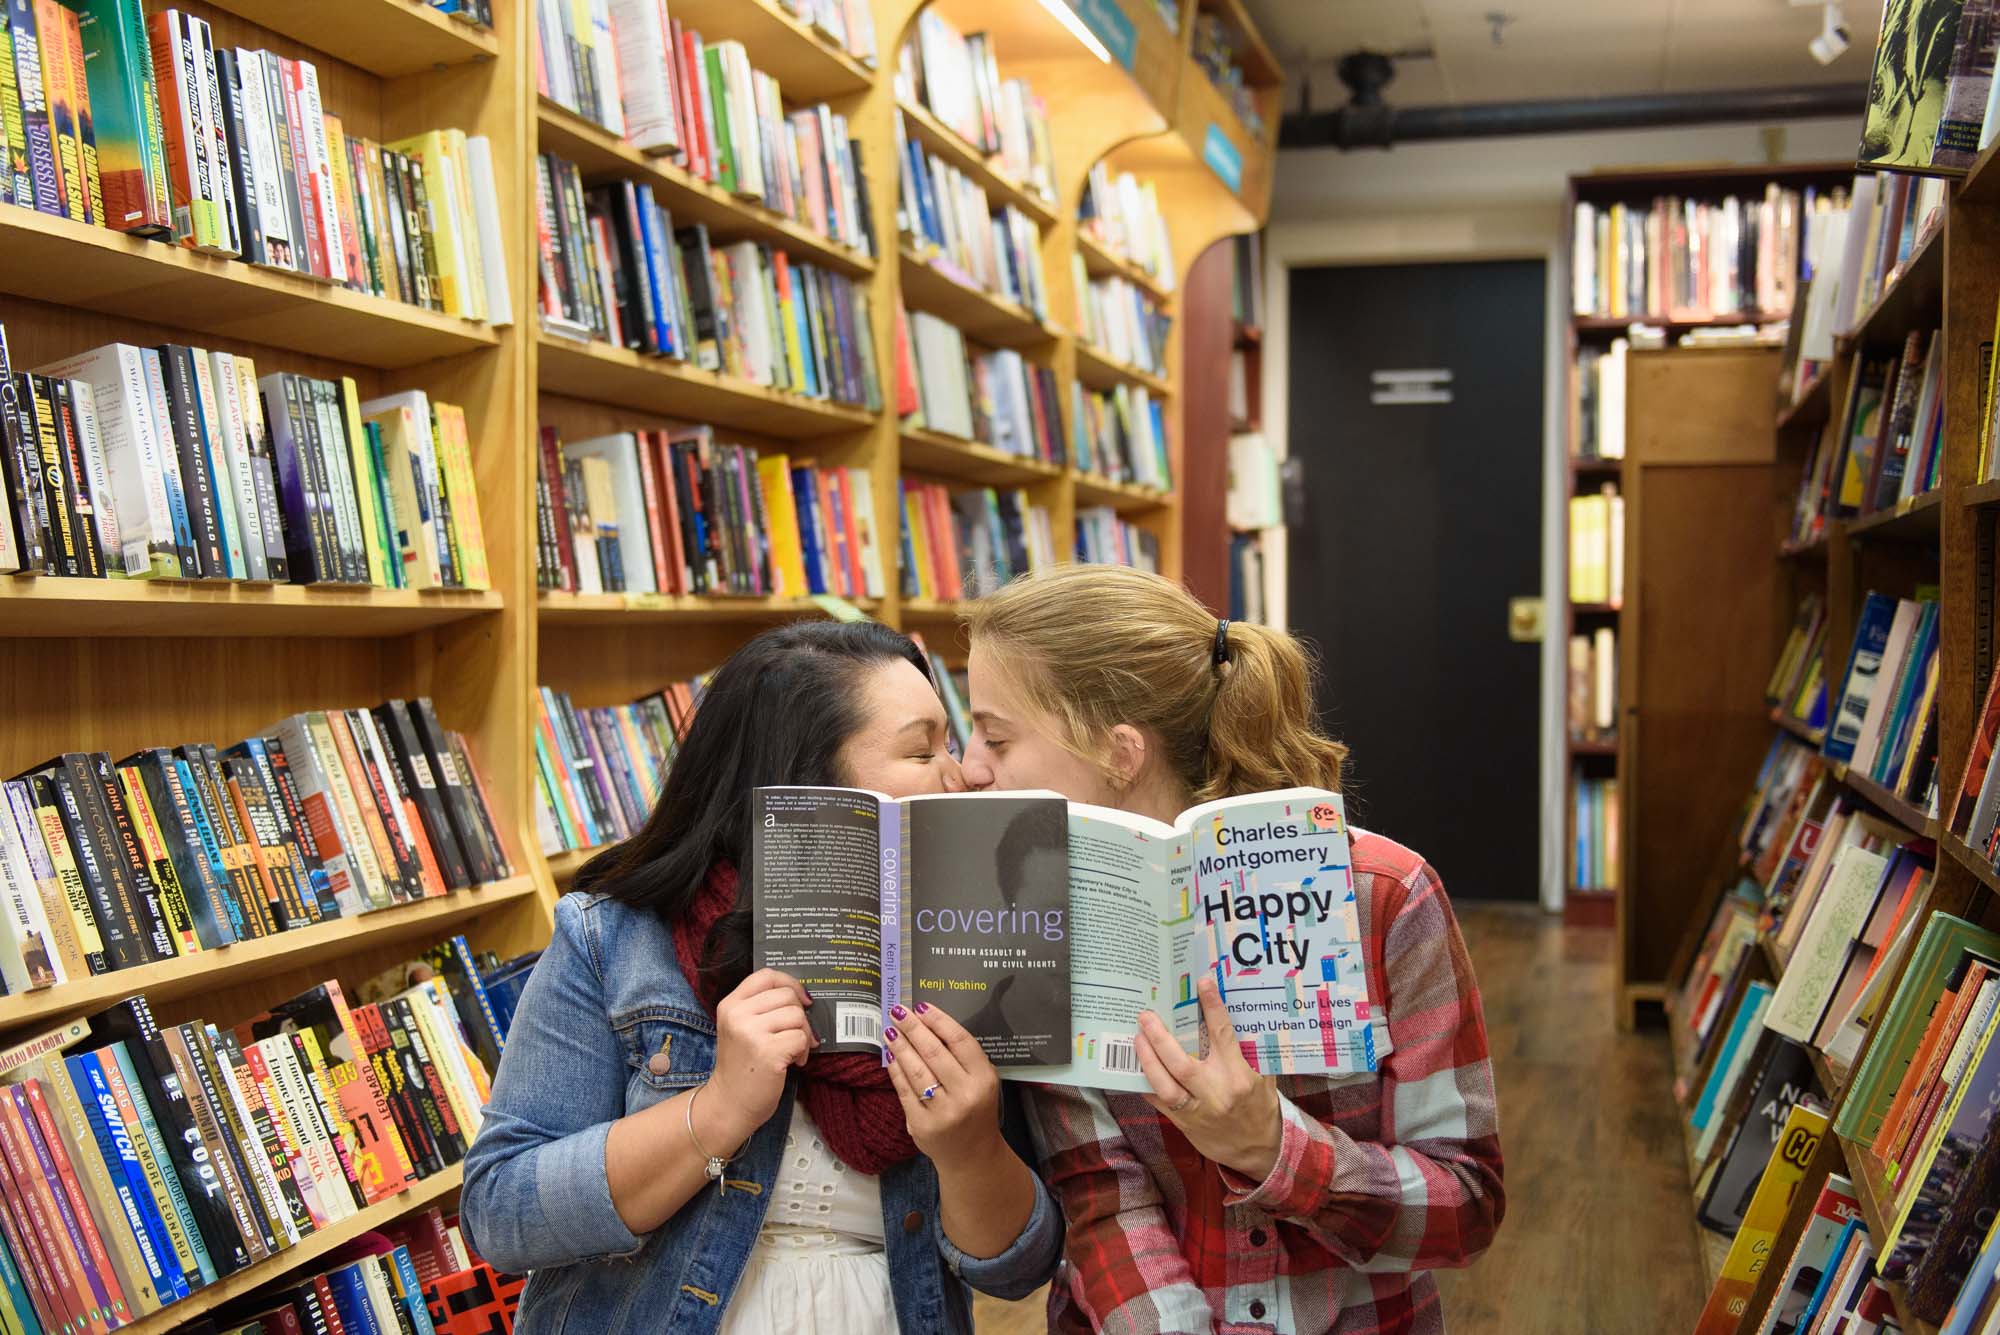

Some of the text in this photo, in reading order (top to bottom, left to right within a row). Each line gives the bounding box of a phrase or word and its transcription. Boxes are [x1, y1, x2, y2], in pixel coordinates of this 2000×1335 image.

[13, 26, 37, 112] KELLERMAN
[26, 34, 46, 112] JONATHAN
[182, 38, 212, 201] the kepler
[312, 114, 326, 160] TEMPLAR
[144, 93, 165, 201] MURDERER'S DAUGHTER
[15, 174, 33, 209] GUILT
[31, 128, 59, 214] OBSESSION
[59, 133, 85, 224] COMPULSION
[83, 143, 106, 227] COMPULSION
[218, 161, 231, 200] kepler
[1, 383, 17, 422] Cut
[130, 367, 153, 461] WILLIAM LANDAY
[34, 392, 61, 466] JON LAND
[177, 355, 216, 542] RICHARD THIS WICKED WORLD
[221, 360, 260, 538] JOHN LAWTON BLACK OUT
[61, 405, 94, 549] MISSION WILLIAM
[106, 508, 121, 551] DEFENDING
[262, 509, 275, 544] DEATH
[267, 493, 281, 533] LITTLE
[416, 757, 432, 786] ALEX
[444, 755, 459, 784] ALEX
[165, 766, 194, 825] PATRICK LEE
[193, 763, 227, 848] DENNIS LEHANE
[209, 760, 244, 844] DENNIS LEHANE
[256, 754, 292, 834] DENNIS LEHANE
[50, 814, 66, 841] JOHN
[104, 783, 145, 870] JOHN LE CARRÉ
[186, 788, 220, 865] DENNIS LEHANE
[300, 815, 319, 857] LEHANE
[387, 816, 410, 863] ISLAND
[1216, 821, 1299, 847] Charles
[59, 782, 115, 921] MOST WANTED MAN
[1170, 865, 1192, 876] Happy
[1199, 844, 1329, 877] Montgomery
[13, 893, 31, 926] TRAITOR
[60, 868, 82, 912] PILGRIM
[69, 868, 97, 928] THE SECRET
[115, 881, 139, 935] MISSION SONG
[167, 892, 183, 928] Panama
[169, 880, 185, 914] Tailor
[881, 848, 901, 927] covering
[1122, 885, 1132, 894] City
[1203, 889, 1333, 926] Happy
[146, 893, 173, 956] MOST WANTED
[916, 902, 1064, 942] covering
[884, 943, 897, 971] Kenji
[931, 947, 1027, 957] THE HIDDEN ASSAULT ON
[983, 960, 1057, 968] OUR CIVIL RIGHTS
[1232, 931, 1311, 971] City
[919, 978, 987, 991] Kenji Yoshino
[1226, 997, 1351, 1014] nsforming Our Lives
[131, 1000, 152, 1042] LEONARD
[139, 996, 158, 1033] ELMORE
[1232, 1018, 1352, 1034] rough Urban Design
[27, 1032, 67, 1059] BREMONT
[51, 1060, 73, 1105] DONNA
[164, 1077, 184, 1102] BE
[183, 1028, 227, 1125] ELMORE LEONARD
[232, 1065, 257, 1113] LEONARD
[242, 1063, 266, 1109] ELMORE
[264, 1076, 283, 1116] ELMORE
[362, 1066, 391, 1121] LEONARD
[41, 1111, 57, 1139] DONNA
[90, 1068, 138, 1162] THE SWITCH
[268, 1057, 325, 1184] Elmore Leonard STICK
[286, 1055, 340, 1178] Elmore Leonard STICK
[107, 1066, 188, 1260] SWAG ELMORE LEONARD
[128, 1082, 205, 1255] COMFORT ENEMY ELMORE LEONARD
[184, 1126, 222, 1200] COOL
[190, 1093, 254, 1238] PRONTO ELMORE LEONARD
[267, 1143, 280, 1154] THE
[25, 1116, 90, 1266] DONNA DOCTORED EVIDENCE
[83, 1102, 162, 1279] KILLSHOT ELMORE LEONARD
[241, 1138, 279, 1221] ELMORE LEONARD
[263, 1169, 279, 1201] SHORTY
[276, 1167, 292, 1183] KID
[53, 1256, 71, 1289] DREAMS
[398, 1252, 416, 1295] Black
